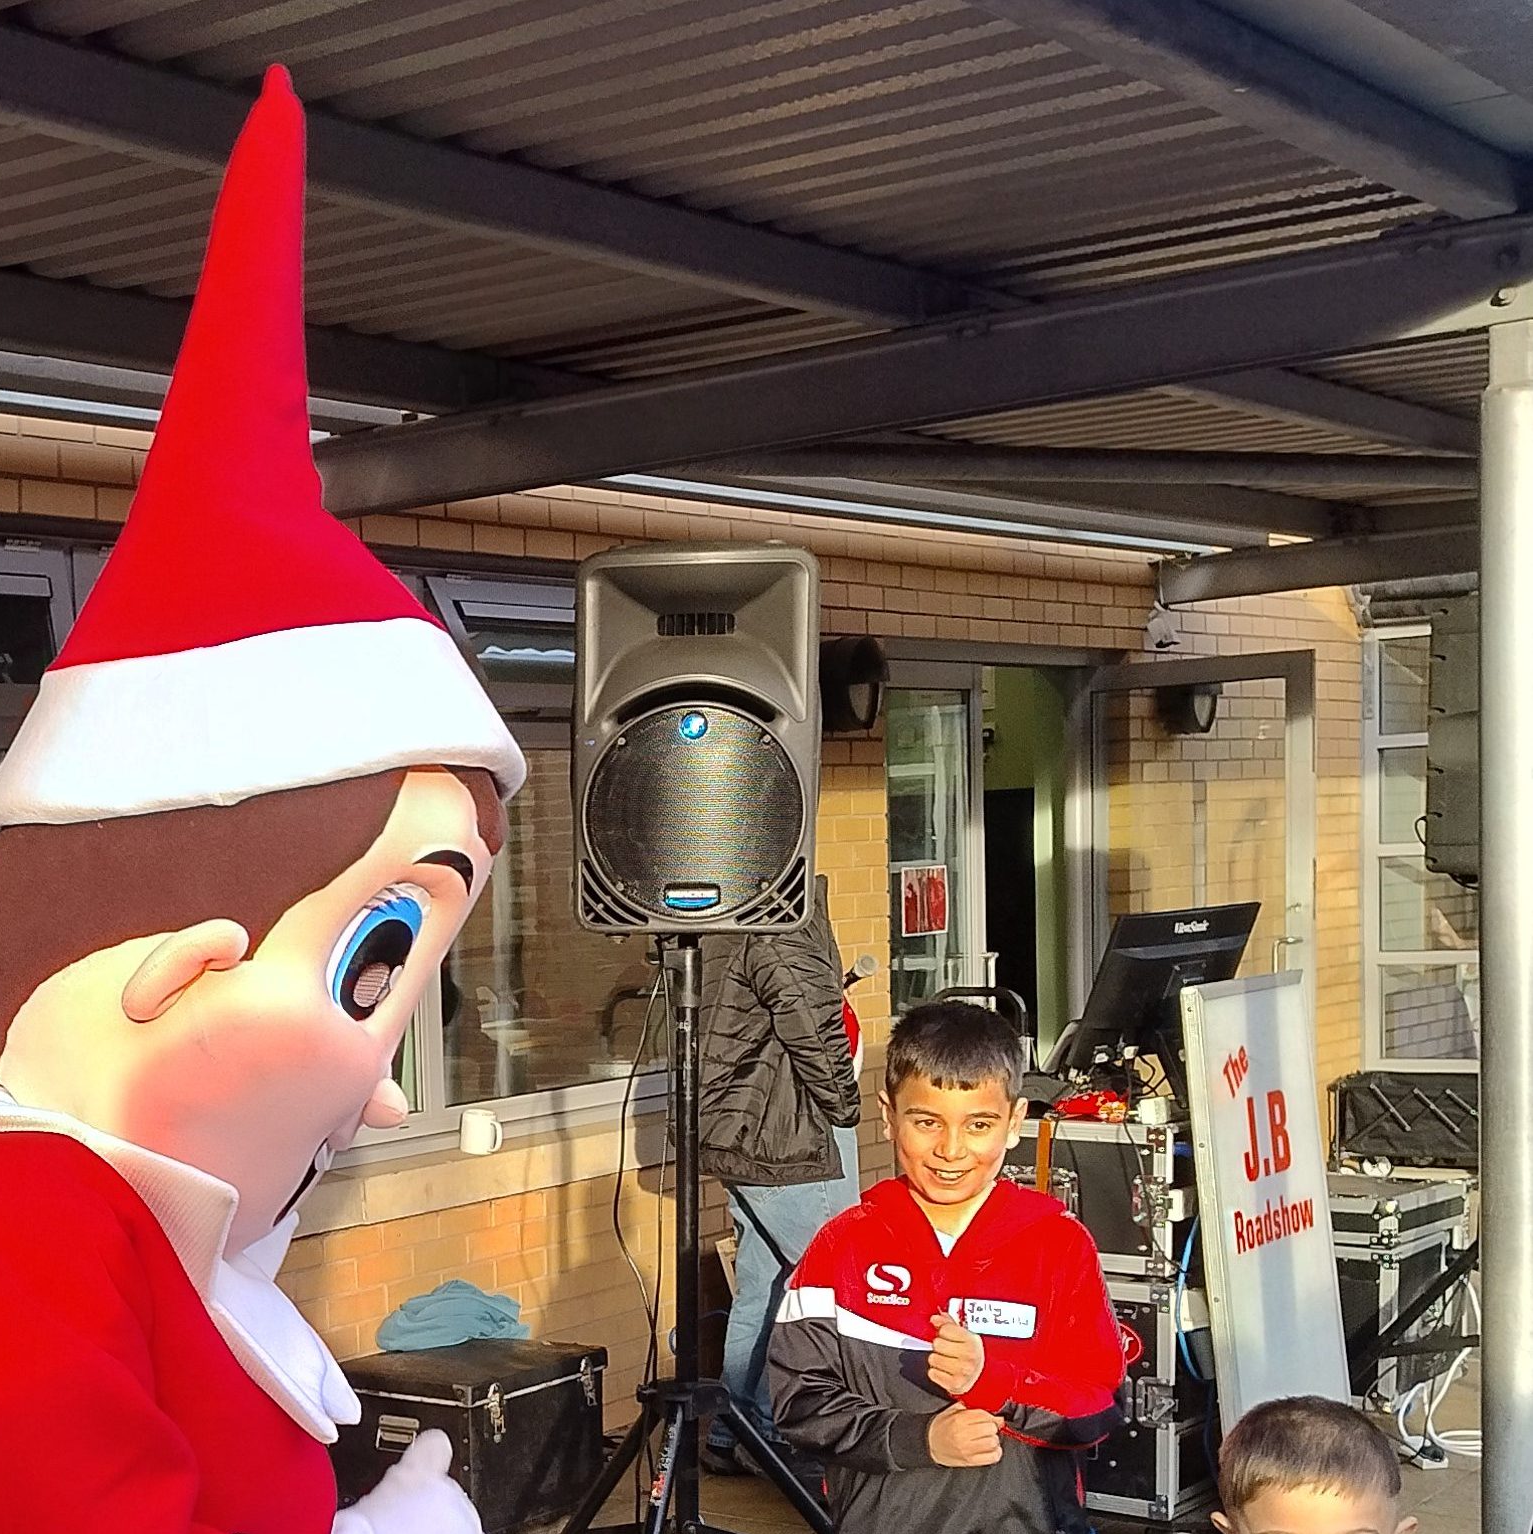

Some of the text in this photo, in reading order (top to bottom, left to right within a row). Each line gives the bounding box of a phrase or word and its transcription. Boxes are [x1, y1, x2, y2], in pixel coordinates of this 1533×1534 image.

[1222, 1045, 1249, 1098] The
[1244, 1090, 1291, 1182] J.B
[1234, 1196, 1314, 1254] Roadshow
